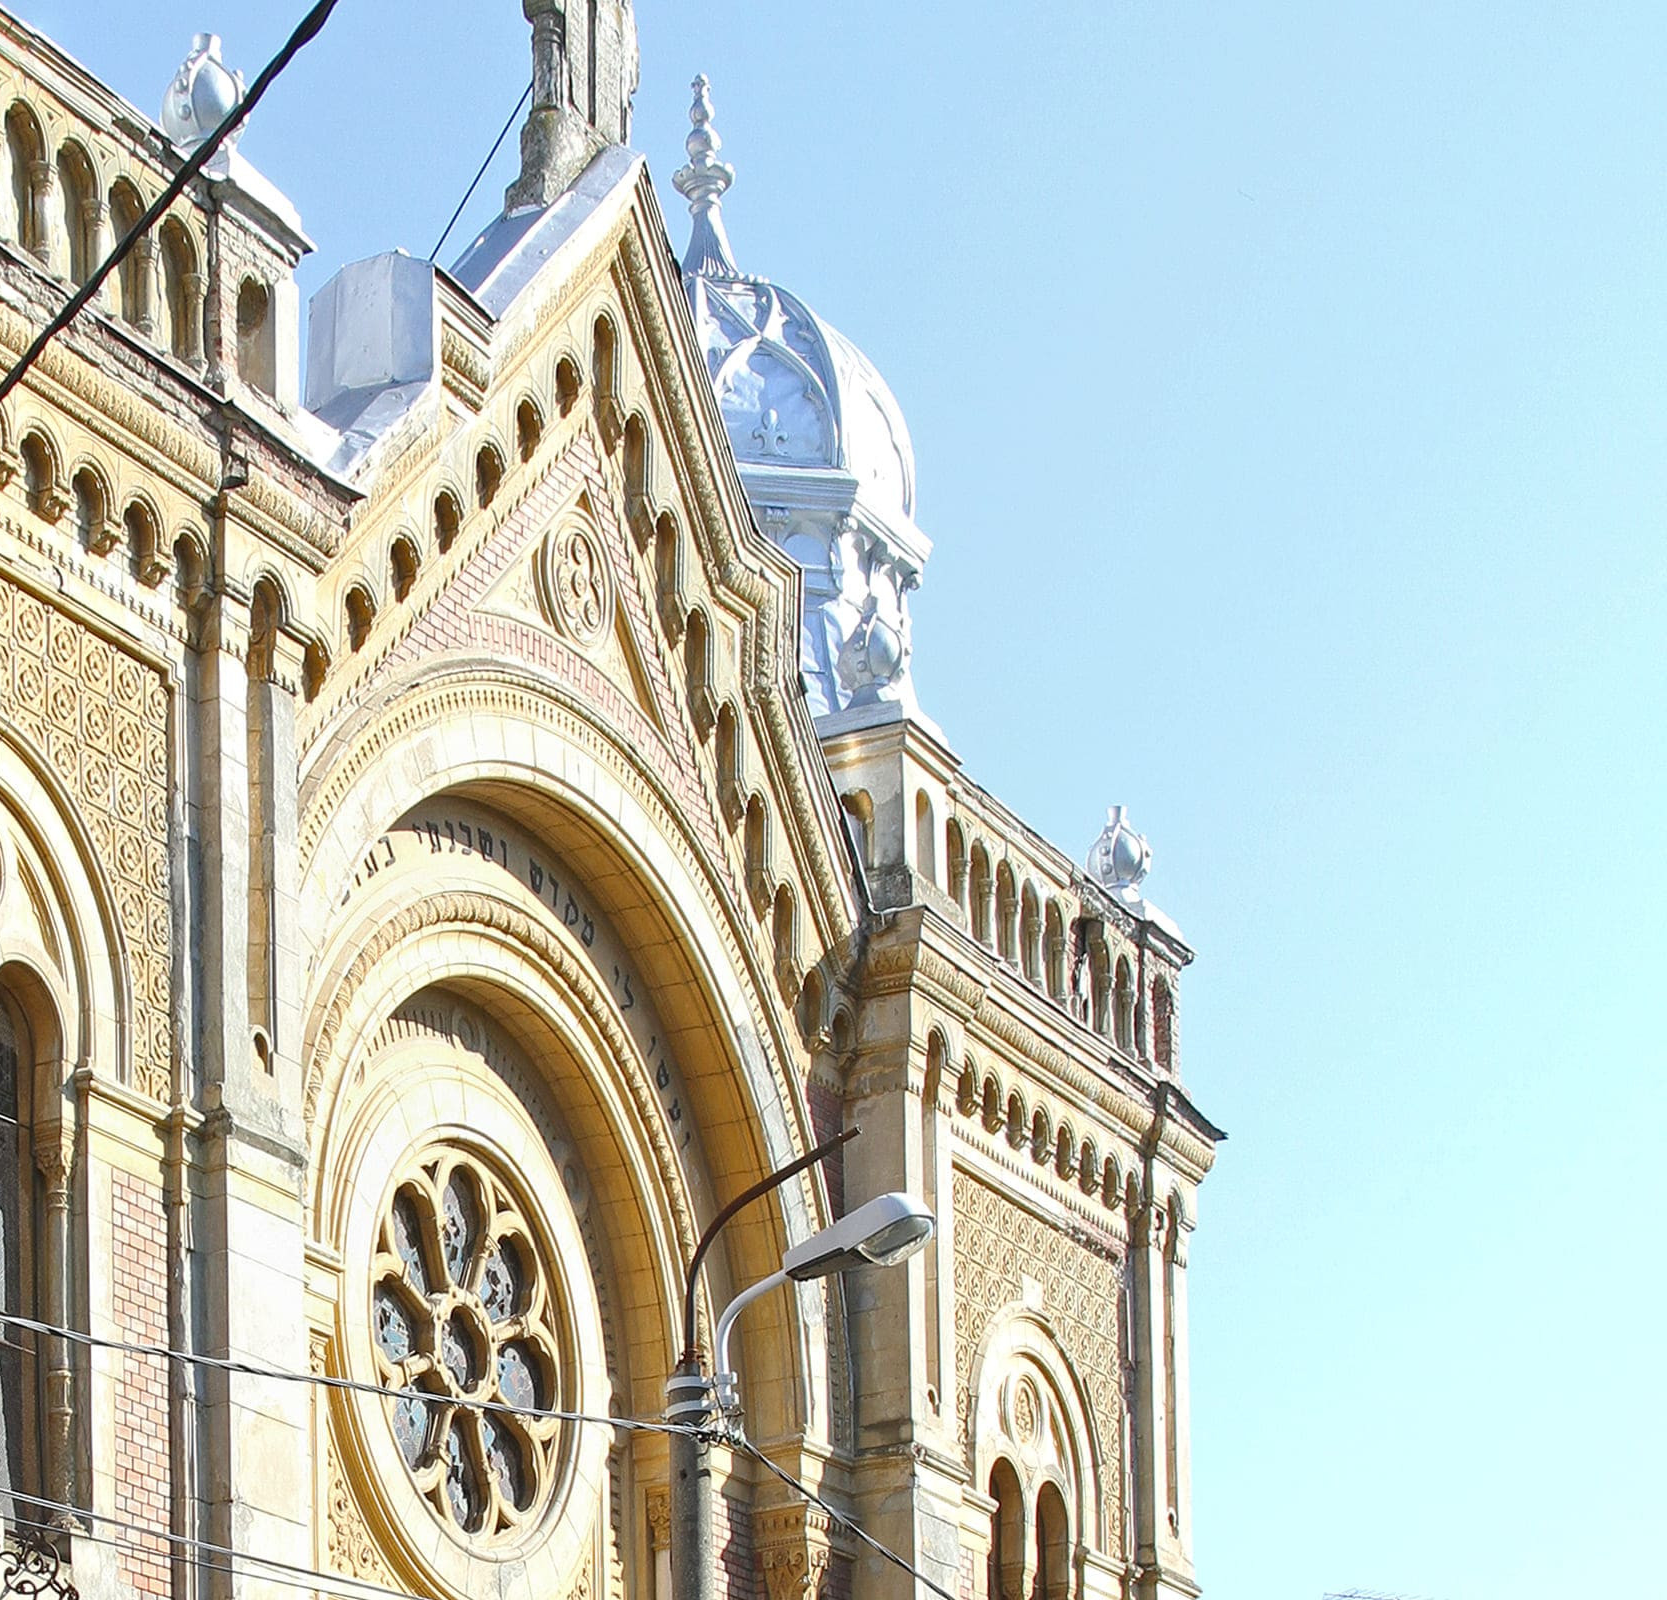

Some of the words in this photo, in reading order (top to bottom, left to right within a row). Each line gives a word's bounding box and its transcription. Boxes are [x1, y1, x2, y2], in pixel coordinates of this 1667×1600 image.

[411, 819, 508, 869] ושכנתי
[528, 857, 595, 948] מקדש
[613, 964, 635, 1012] לי
